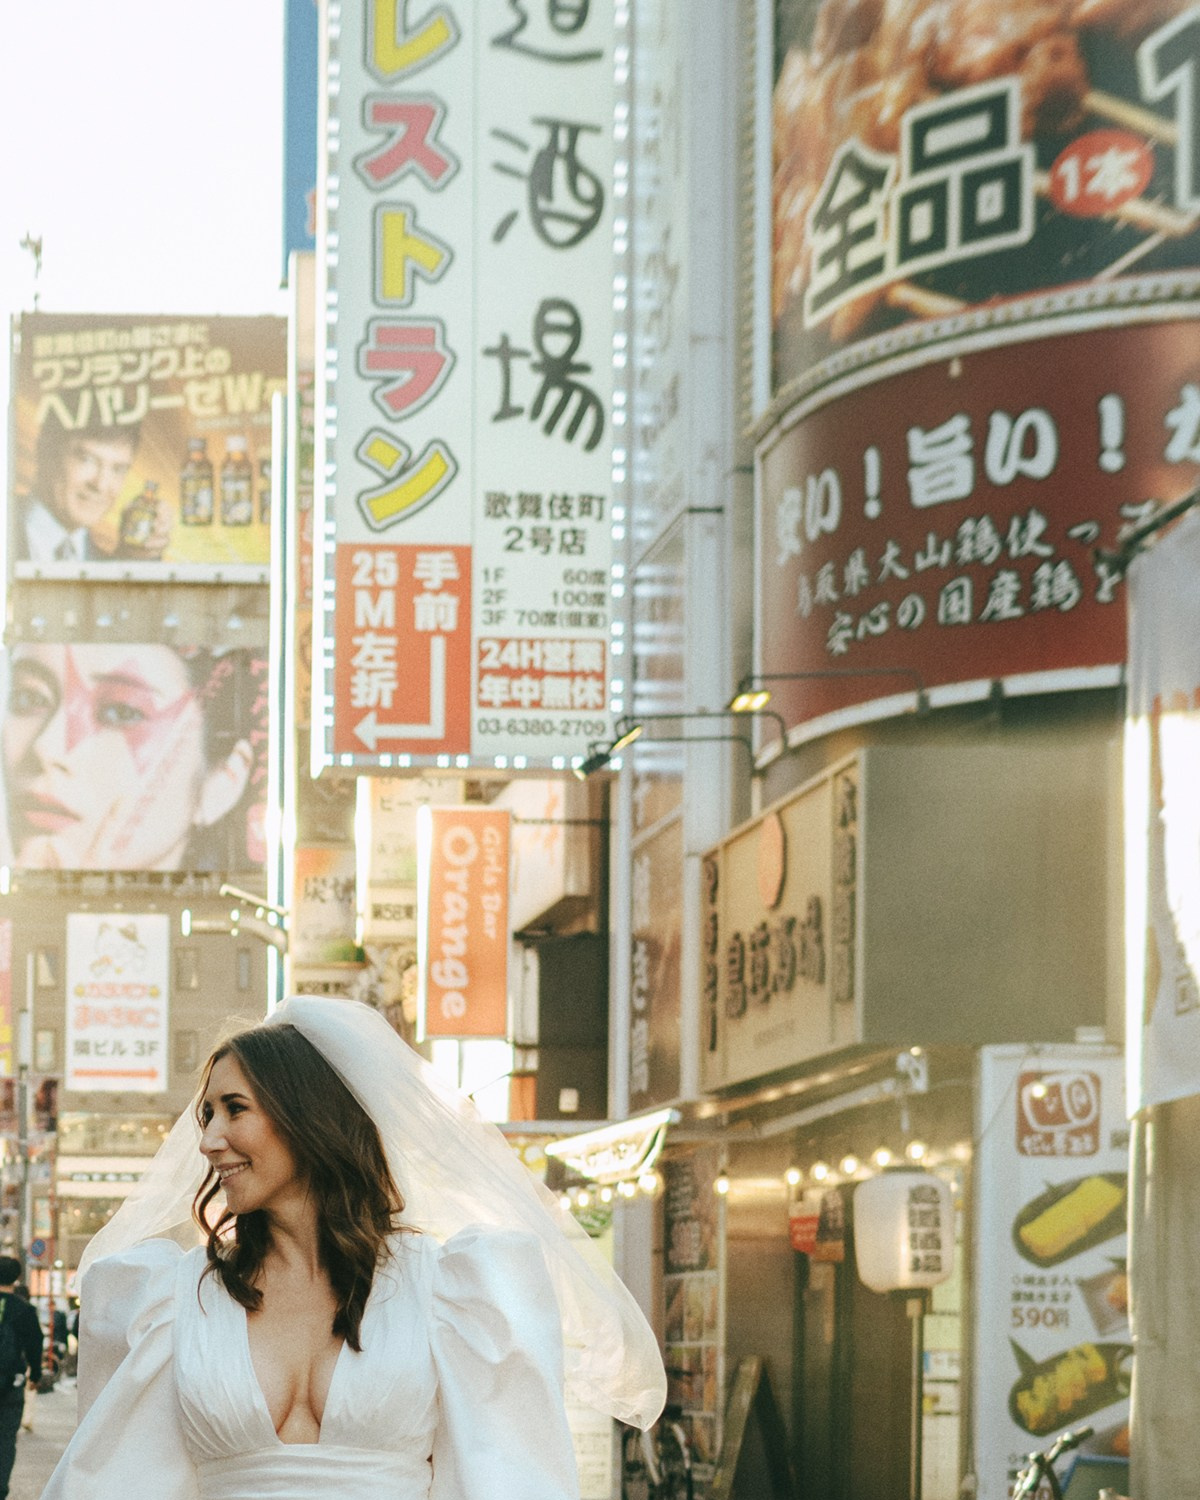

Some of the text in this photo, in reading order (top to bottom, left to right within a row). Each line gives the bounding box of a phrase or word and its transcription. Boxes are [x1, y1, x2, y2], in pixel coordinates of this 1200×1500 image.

[804, 73, 1038, 330] 全品
[32, 346, 233, 390] ワンランク上の
[483, 493, 606, 522] 歌舞伎町
[504, 526, 586, 556] 2号店
[482, 567, 506, 583] 1F
[412, 551, 460, 633] 手前
[482, 588, 507, 605] 2F
[351, 551, 399, 709] 25M左折
[481, 609, 507, 626] 3F
[479, 639, 604, 673] 24H営業
[479, 674, 604, 709] 年中無休
[477, 718, 607, 737] 03-6380-2709
[431, 825, 481, 1020] Orange
[133, 1039, 160, 1057] 3F
